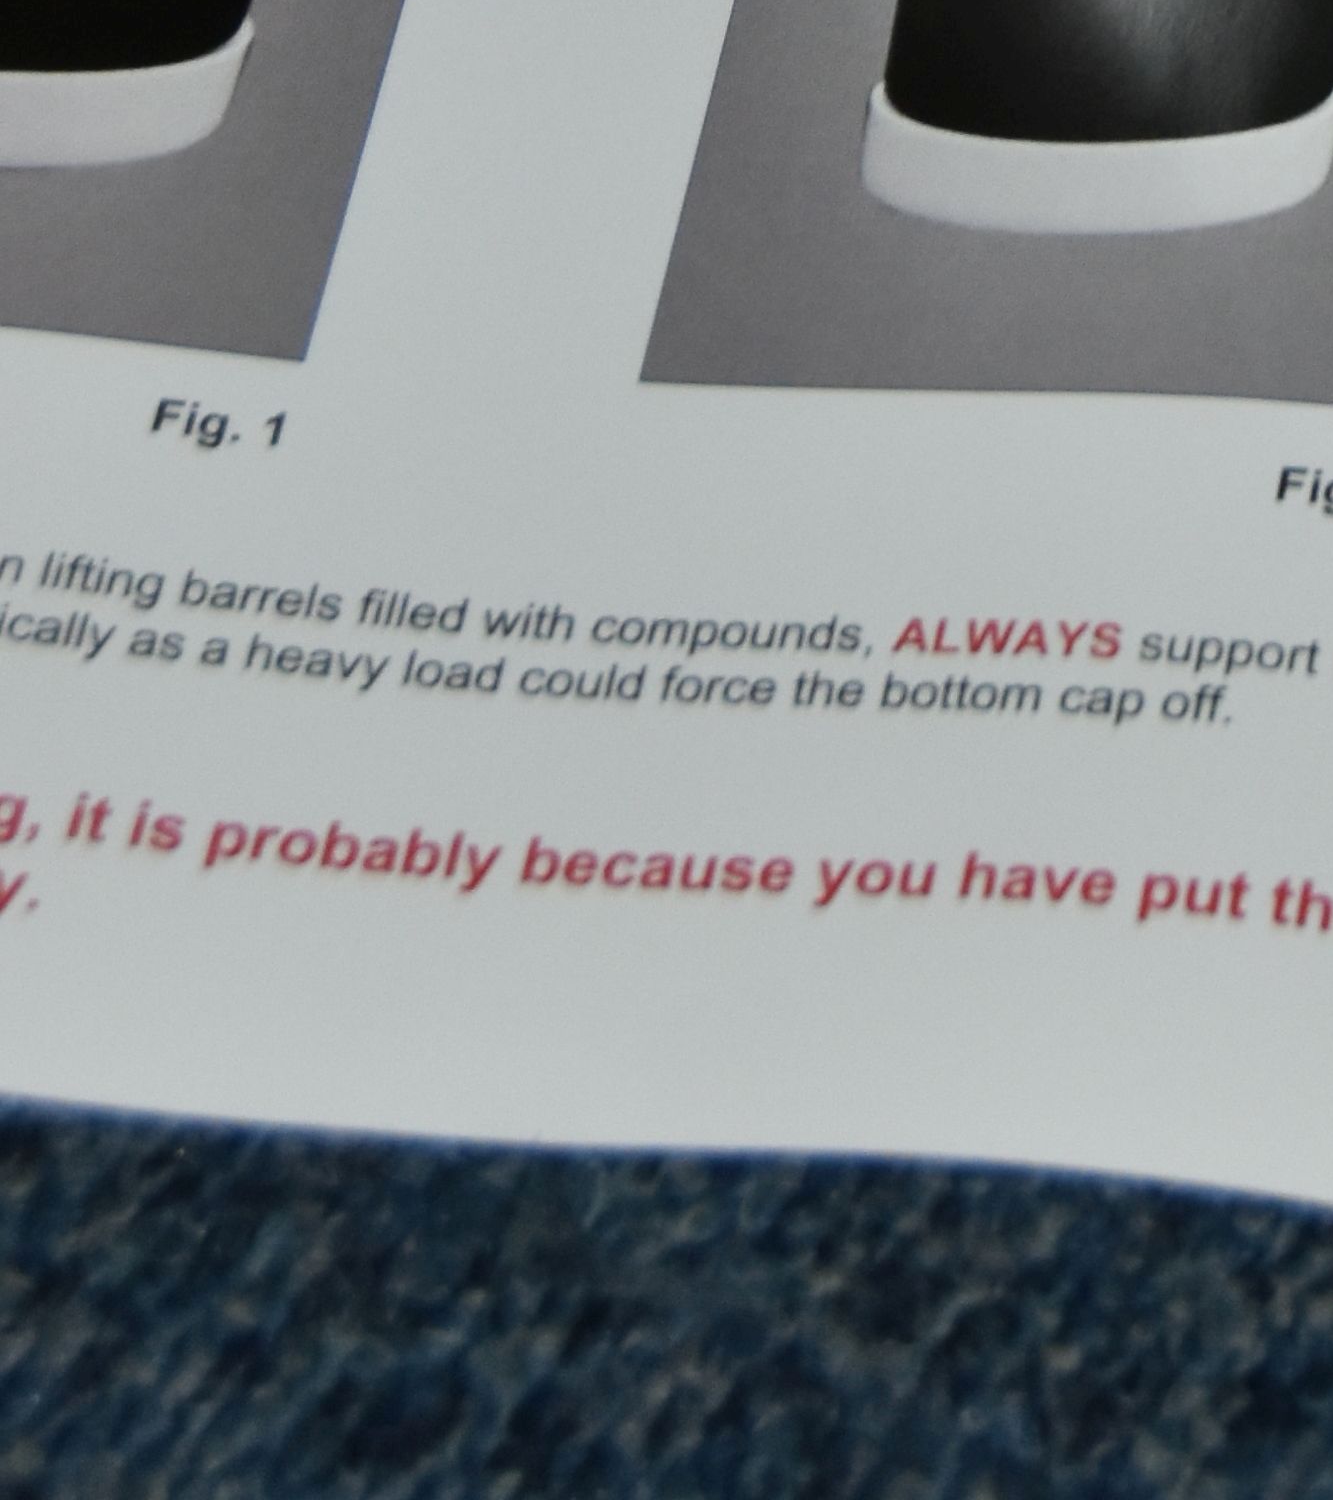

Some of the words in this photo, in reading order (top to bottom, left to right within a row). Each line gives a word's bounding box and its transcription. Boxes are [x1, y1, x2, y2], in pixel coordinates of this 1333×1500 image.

[150, 397, 240, 451] Fig.
[266, 411, 287, 448] 1
[65, 799, 111, 844] it
[127, 800, 184, 854] is
[202, 821, 502, 894] probably
[519, 836, 795, 895] because
[814, 859, 937, 909] you
[958, 851, 1117, 907] have
[1136, 873, 1250, 923] put
